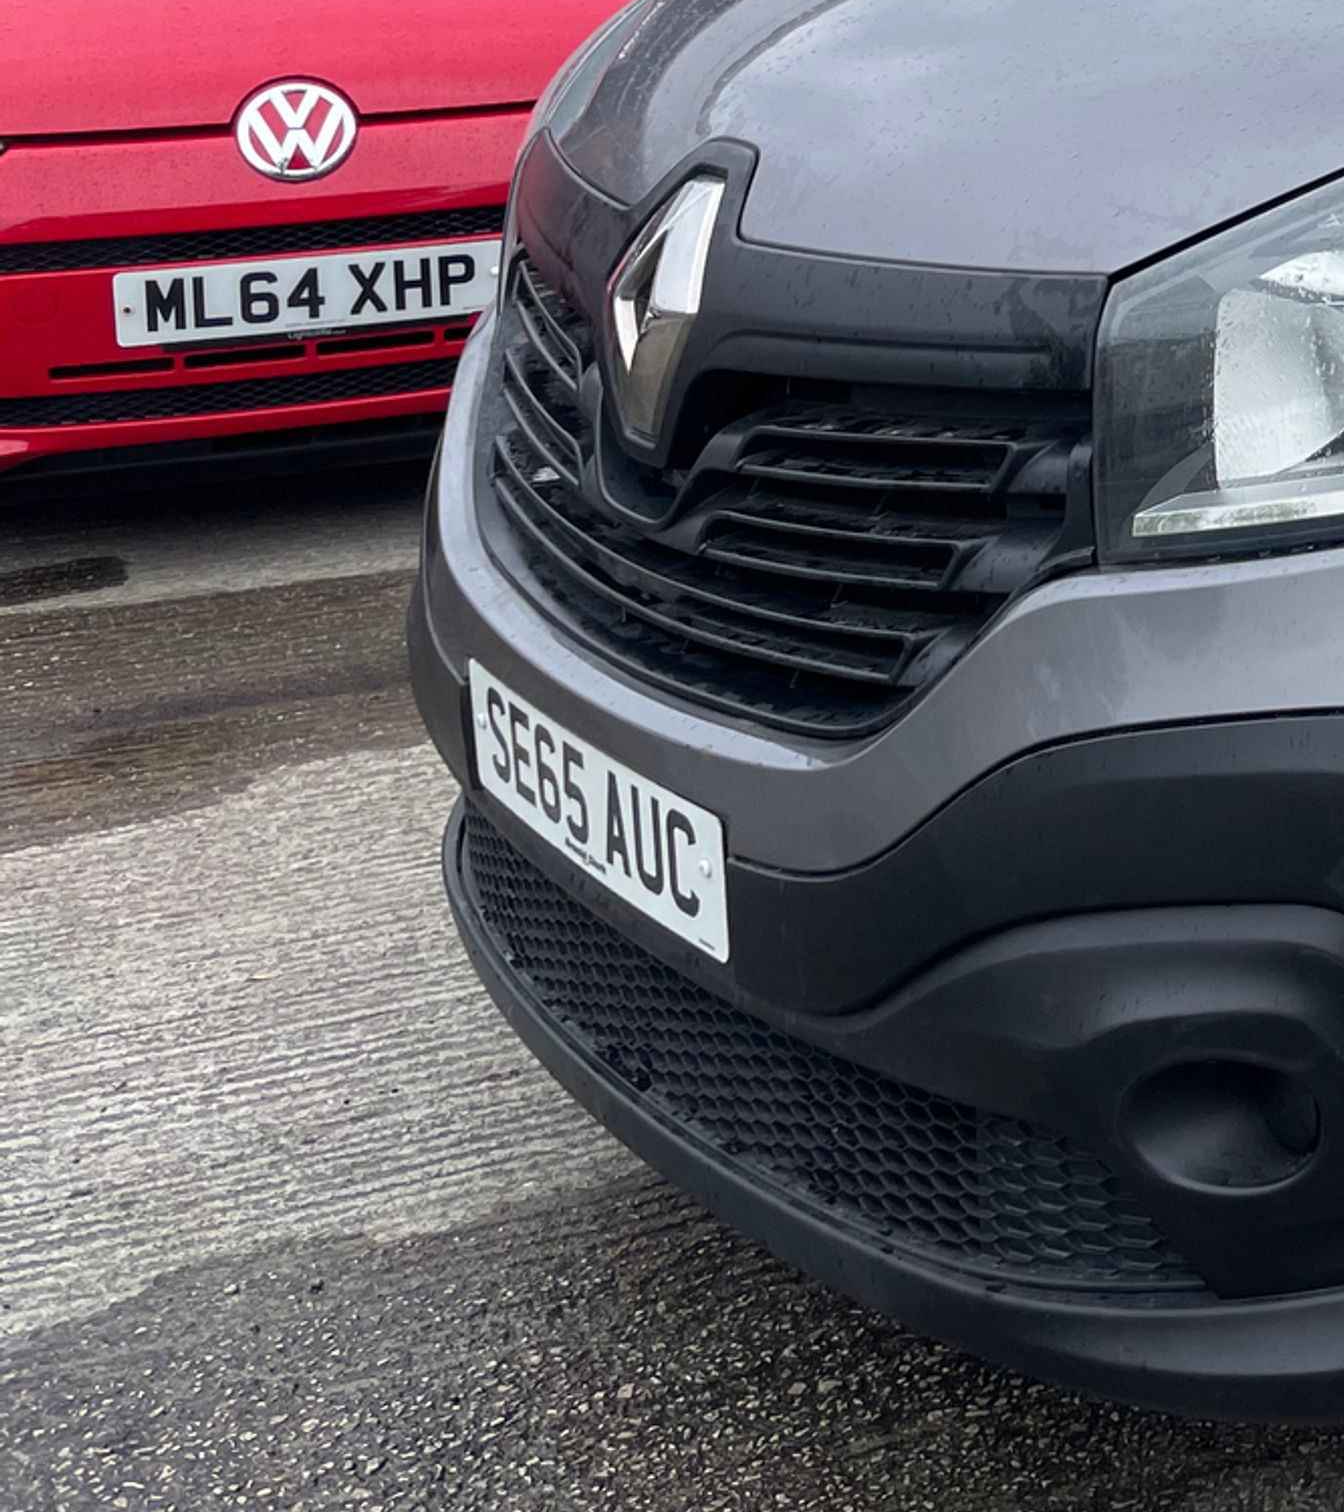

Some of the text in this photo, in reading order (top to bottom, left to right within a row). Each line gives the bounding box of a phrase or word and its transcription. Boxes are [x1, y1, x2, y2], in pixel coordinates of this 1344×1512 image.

[144, 253, 476, 333] ML64 XHP
[485, 686, 700, 918] SE65 AUC
